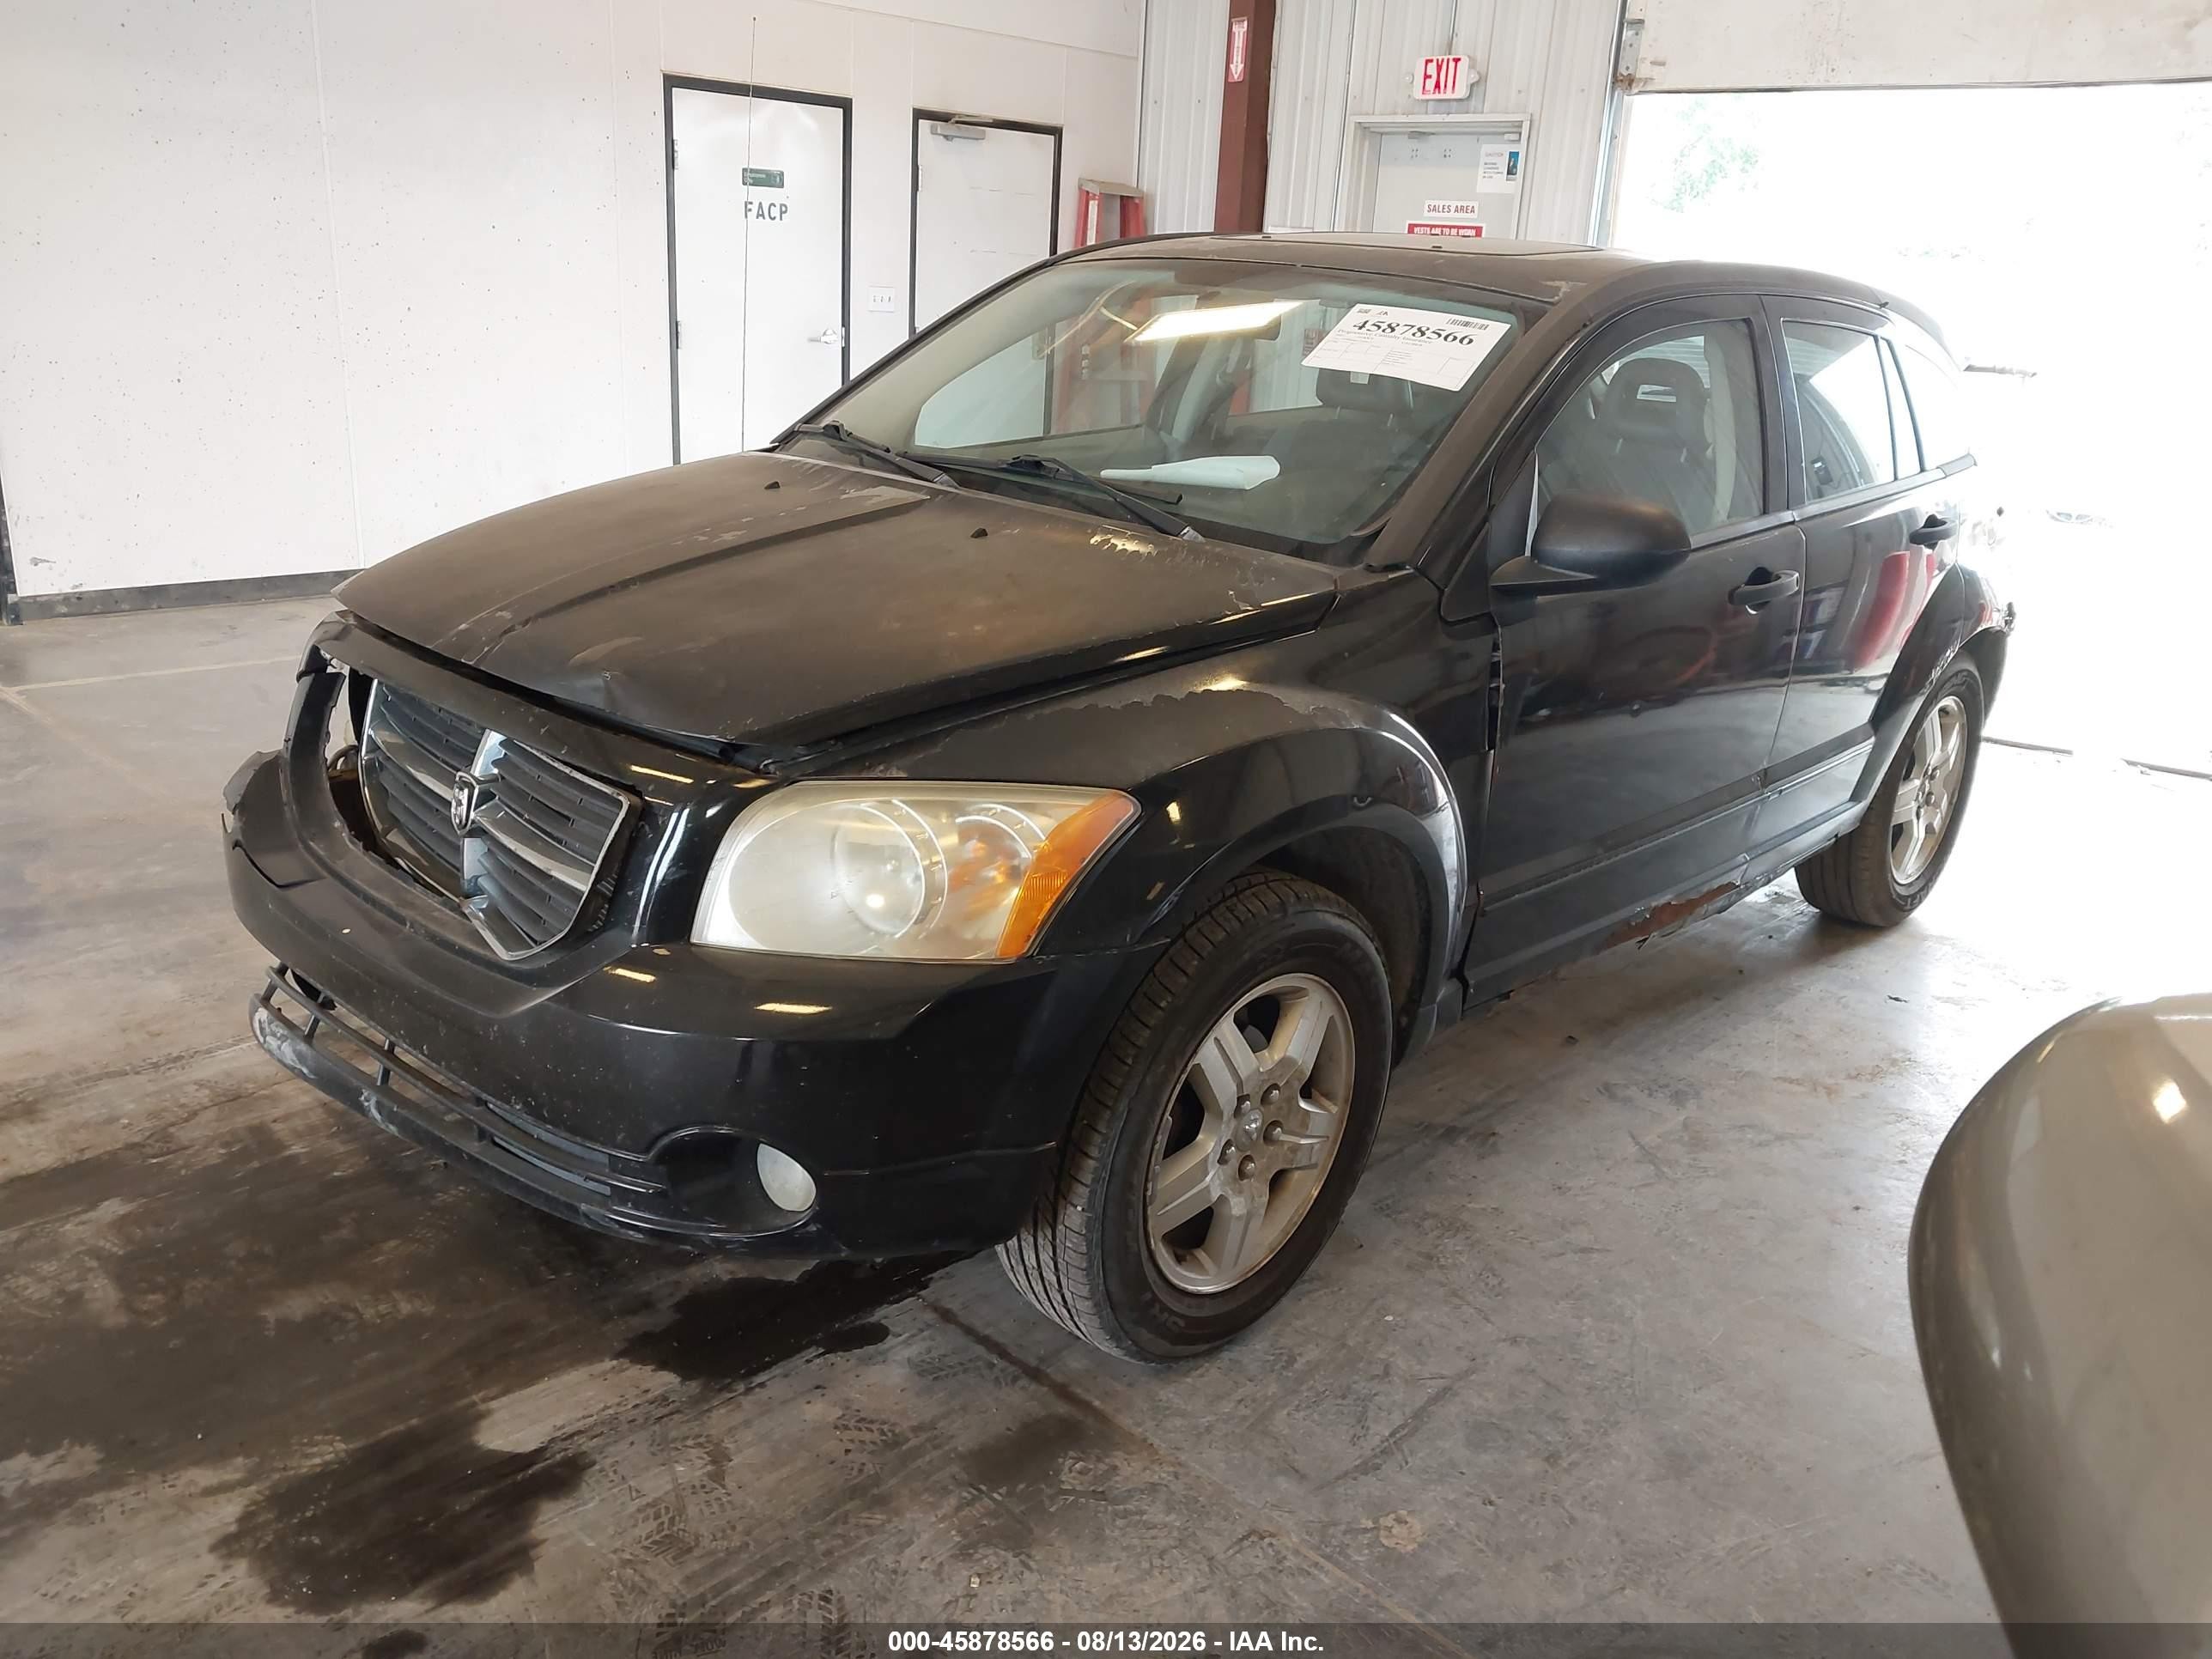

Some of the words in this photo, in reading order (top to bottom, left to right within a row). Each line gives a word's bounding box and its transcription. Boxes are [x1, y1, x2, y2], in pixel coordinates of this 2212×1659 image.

[1422, 58, 1462, 94] EXIT
[744, 201, 788, 221] FACP
[1427, 204, 1452, 214] SALES
[1454, 204, 1475, 214] AREA
[1353, 320, 1477, 345] 45878566
